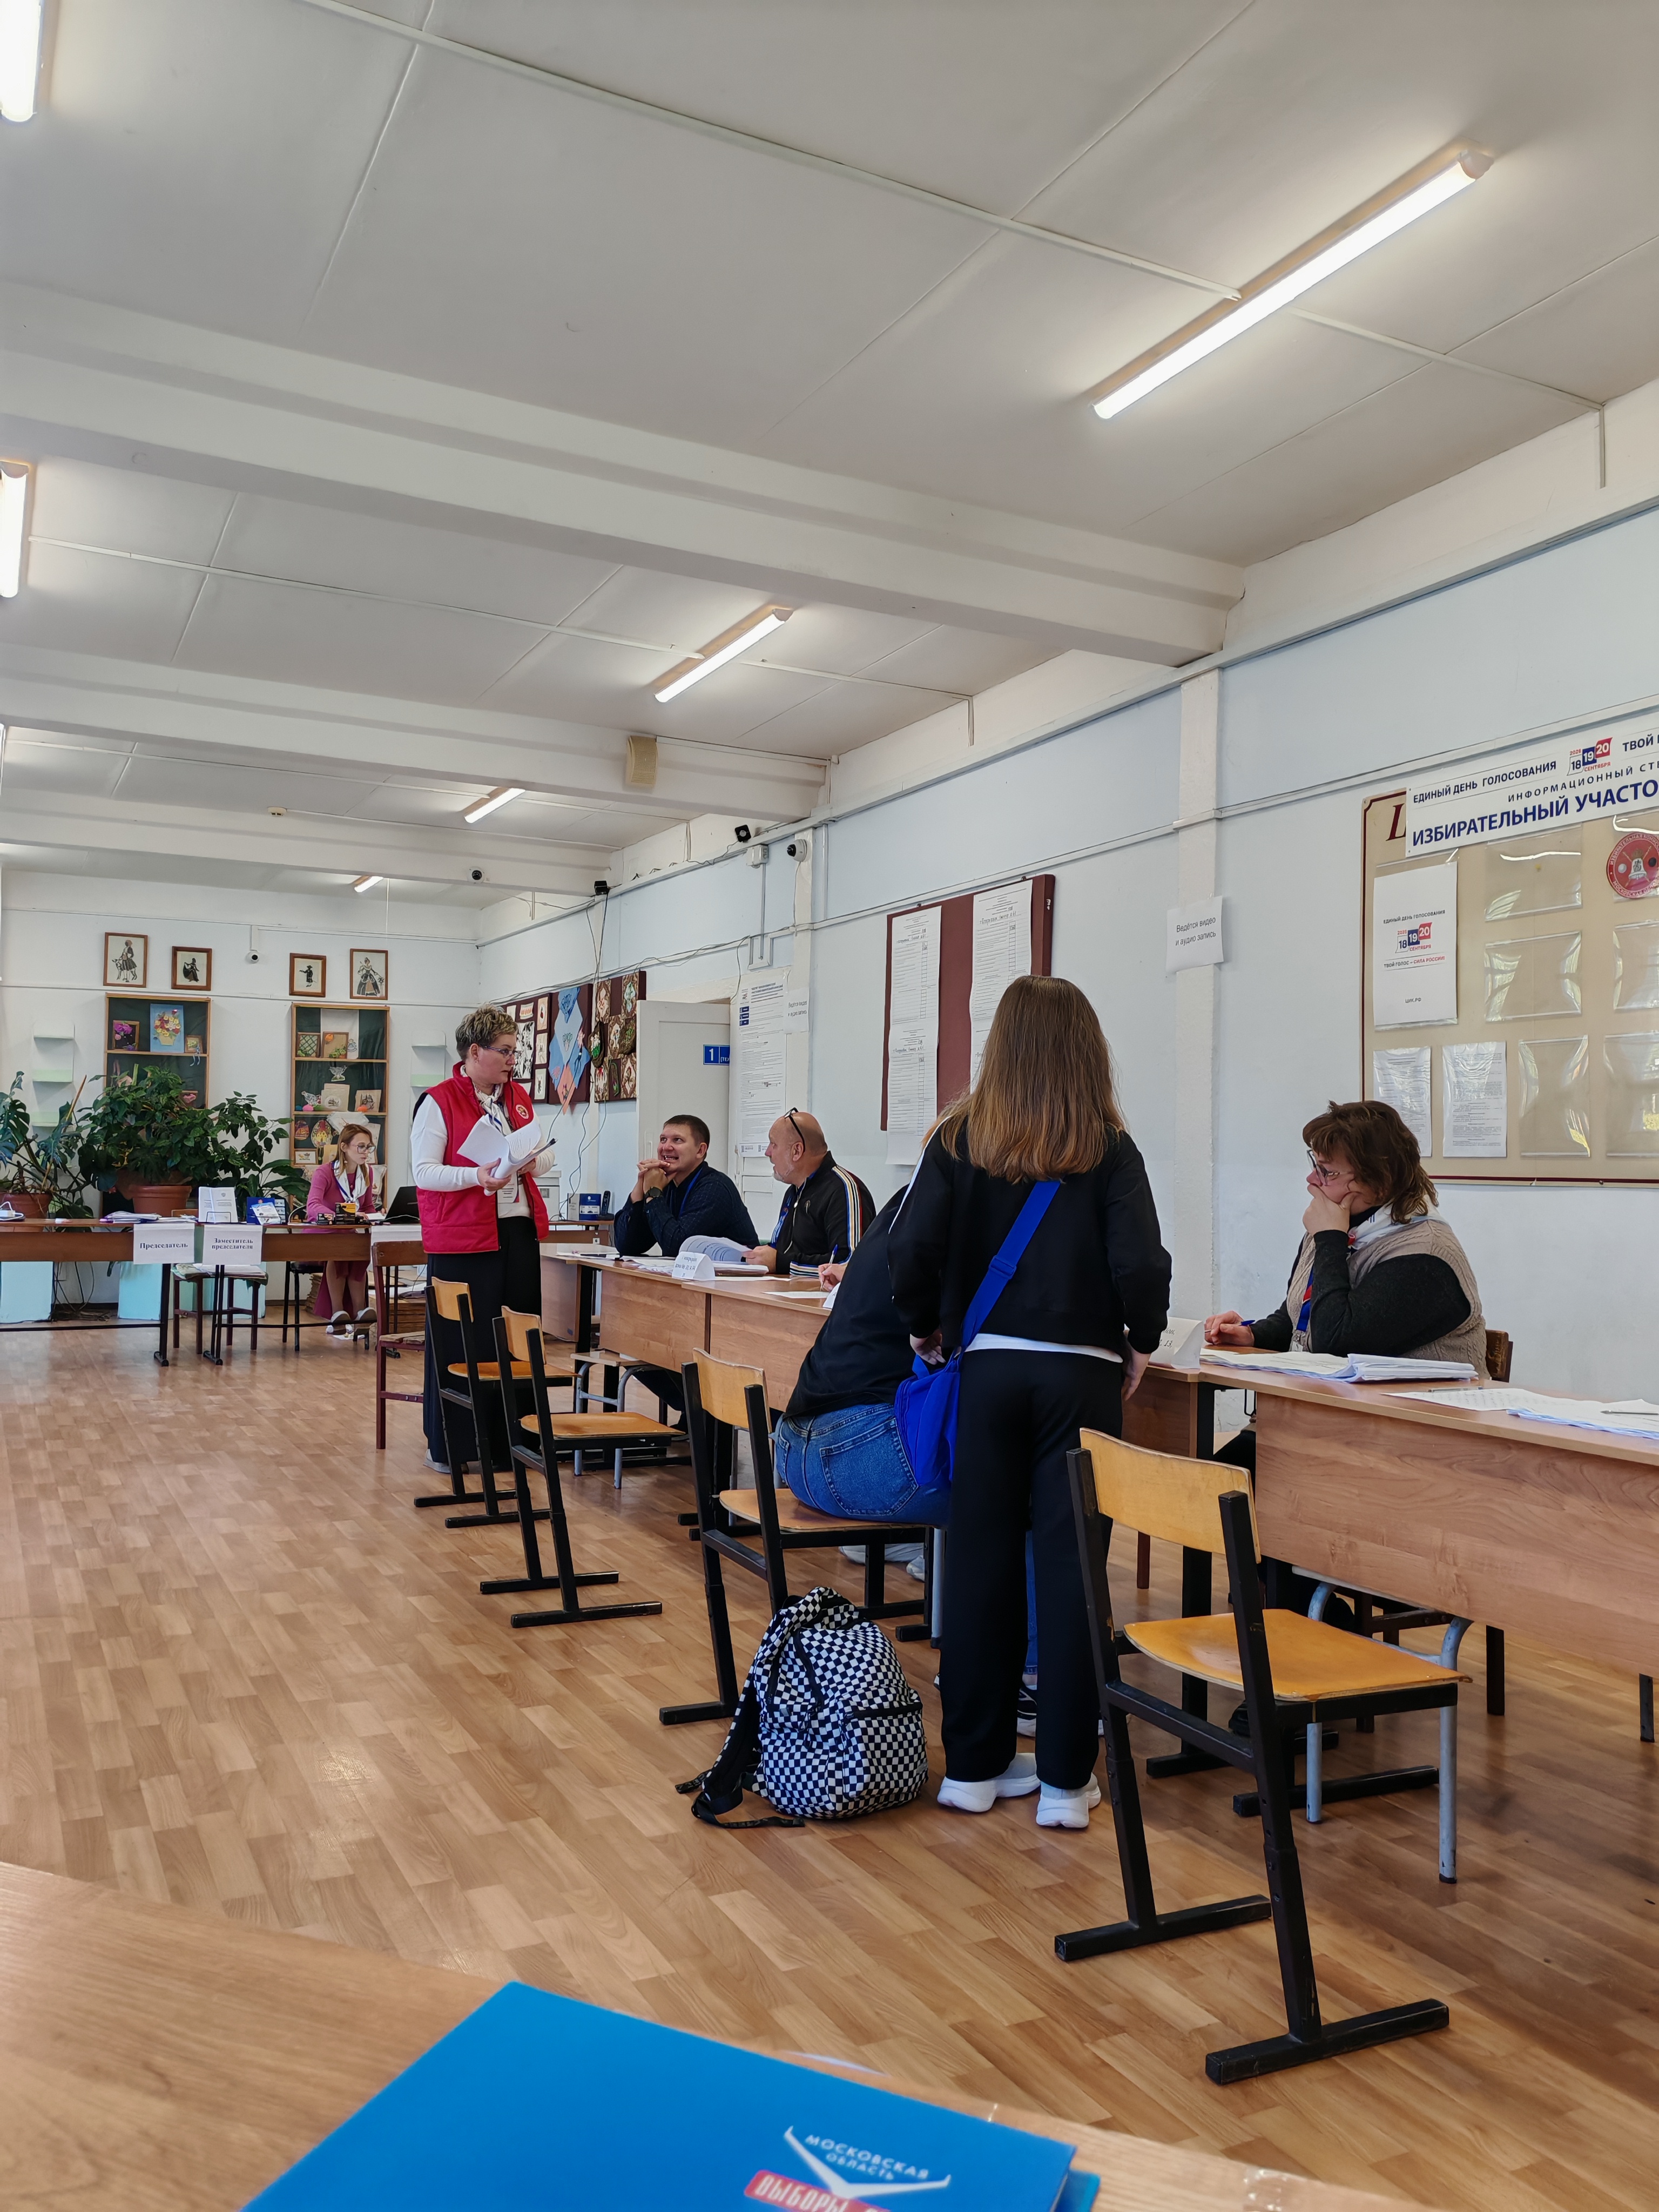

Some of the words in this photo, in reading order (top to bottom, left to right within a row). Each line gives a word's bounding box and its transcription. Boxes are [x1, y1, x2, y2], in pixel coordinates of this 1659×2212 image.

[1622, 733, 1654, 752] ТВОЙ
[1571, 760, 1581, 771] 18
[1583, 751, 1594, 763] 19
[1596, 743, 1609, 754] 20
[1584, 761, 1611, 772] СЕНТЯБРЯ
[1413, 785, 1451, 804] ЕДИНЫЙ
[1453, 781, 1478, 795] ДЕНЬ
[1482, 760, 1556, 787] ГОЛОСОВАНИЯ
[1508, 766, 1633, 802] ИНФОРМАЦИОННЫЙ
[1413, 795, 1568, 846] ИЗБИРАТЕЛЬНЫЙ
[1176, 922, 1199, 933] Ведётся
[1199, 917, 1216, 927] видео
[1384, 916, 1401, 924] ЕДИНЫЙ
[1413, 910, 1445, 919] ГОЛОСОВАНИЯ
[1180, 935, 1196, 946] аудио
[1197, 932, 1216, 941] запись
[1399, 940, 1407, 949] 18
[1408, 933, 1418, 943] 19
[1419, 926, 1429, 936] 20
[709, 1048, 713, 1061] 1
[805, 2134, 929, 2180] МОСКОВСКАЯ
[825, 2153, 894, 2181] ОБЛАСТЬ
[754, 2174, 849, 2212] ВЫБОРЫ
